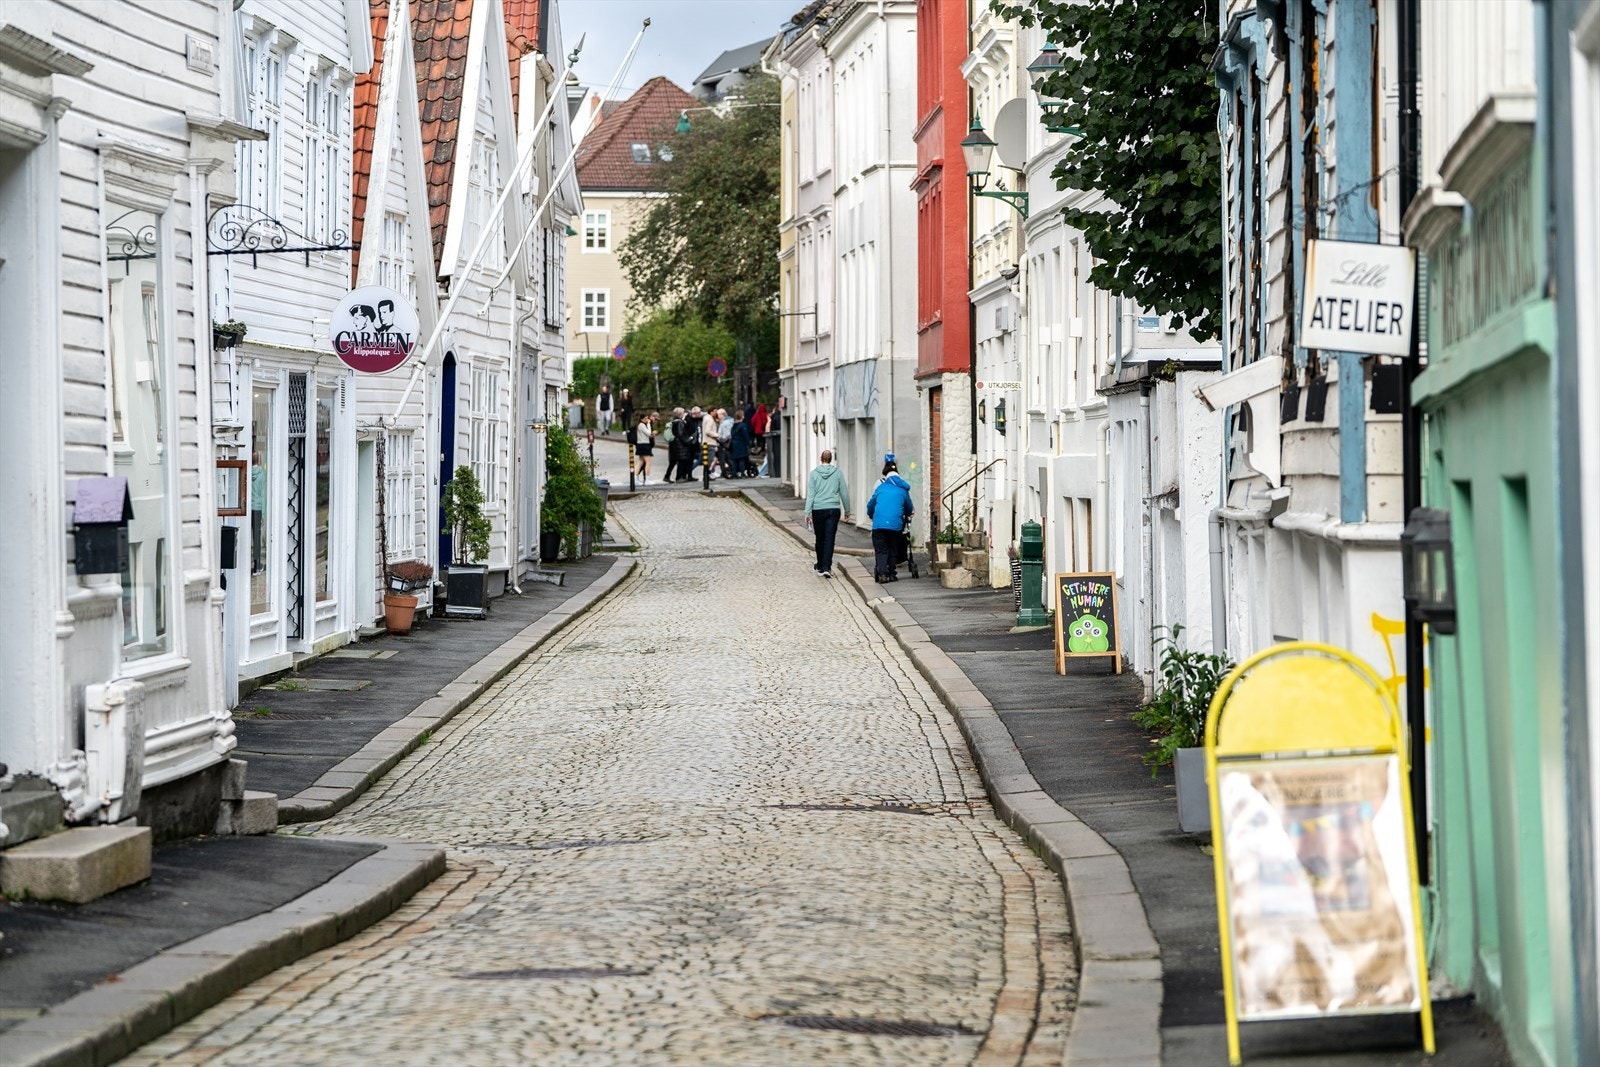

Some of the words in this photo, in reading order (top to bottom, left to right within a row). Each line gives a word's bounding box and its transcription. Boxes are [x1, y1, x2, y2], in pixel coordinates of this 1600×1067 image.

[1330, 259, 1391, 289] Lille
[1310, 296, 1404, 336] ATELIER
[335, 330, 411, 354] CARMEN
[1062, 582, 1080, 596] GET
[1088, 581, 1111, 595] HERE
[1070, 594, 1104, 609] HUMAN
